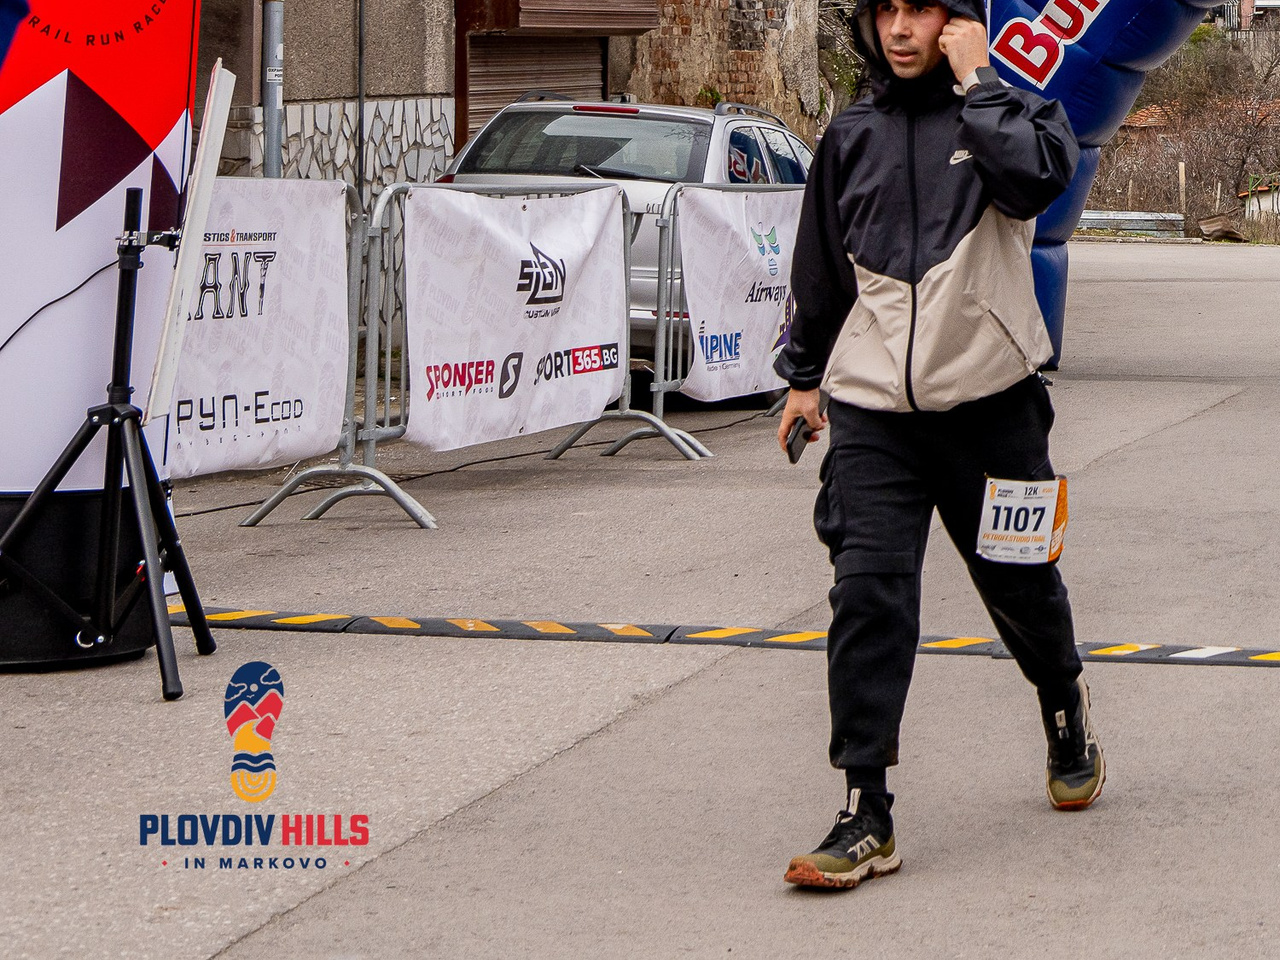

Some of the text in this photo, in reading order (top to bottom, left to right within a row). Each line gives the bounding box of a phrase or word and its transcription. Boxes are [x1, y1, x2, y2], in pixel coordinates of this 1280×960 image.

[28, 15, 72, 43] RAIL
[86, 30, 125, 46] RUN
[190, 251, 277, 321] ANT
[745, 281, 788, 307] Airways
[426, 359, 495, 402] SPONSER
[992, 505, 1046, 532] 1107
